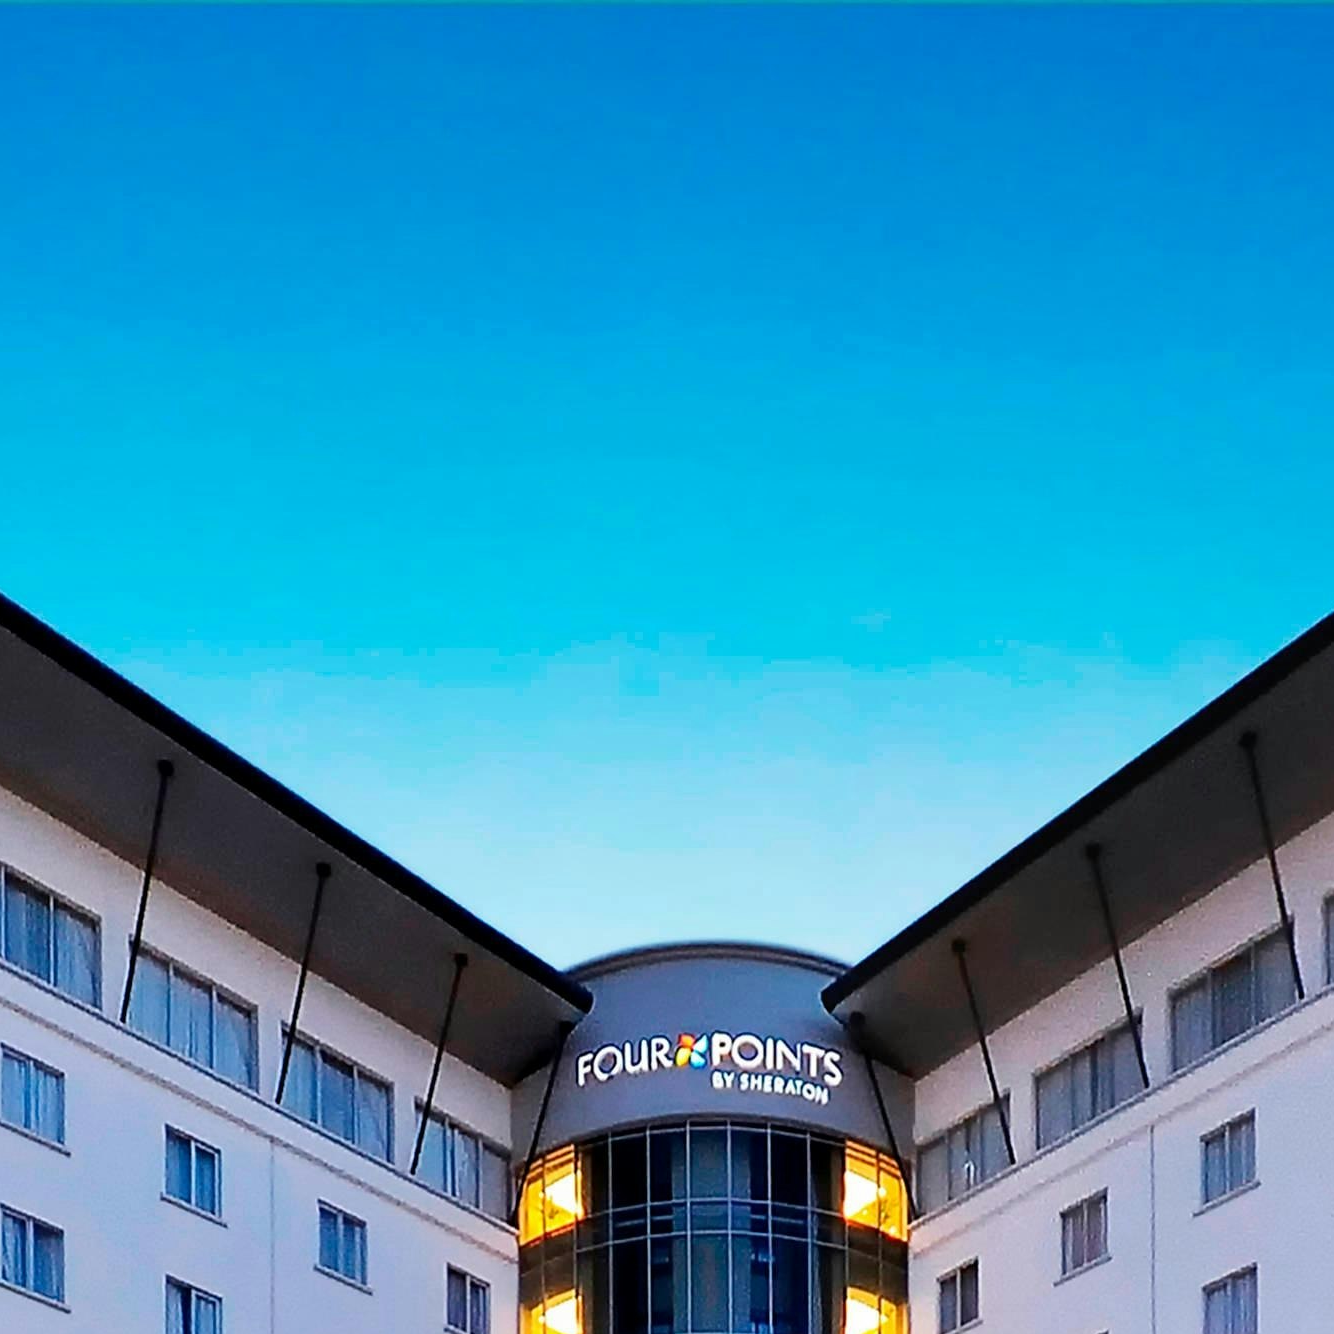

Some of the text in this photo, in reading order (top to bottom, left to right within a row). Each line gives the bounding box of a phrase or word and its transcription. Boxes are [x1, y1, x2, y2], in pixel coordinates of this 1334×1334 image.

[577, 1031, 843, 1087] FOUR POINTS
[712, 1071, 831, 1105] BY SHERATON
